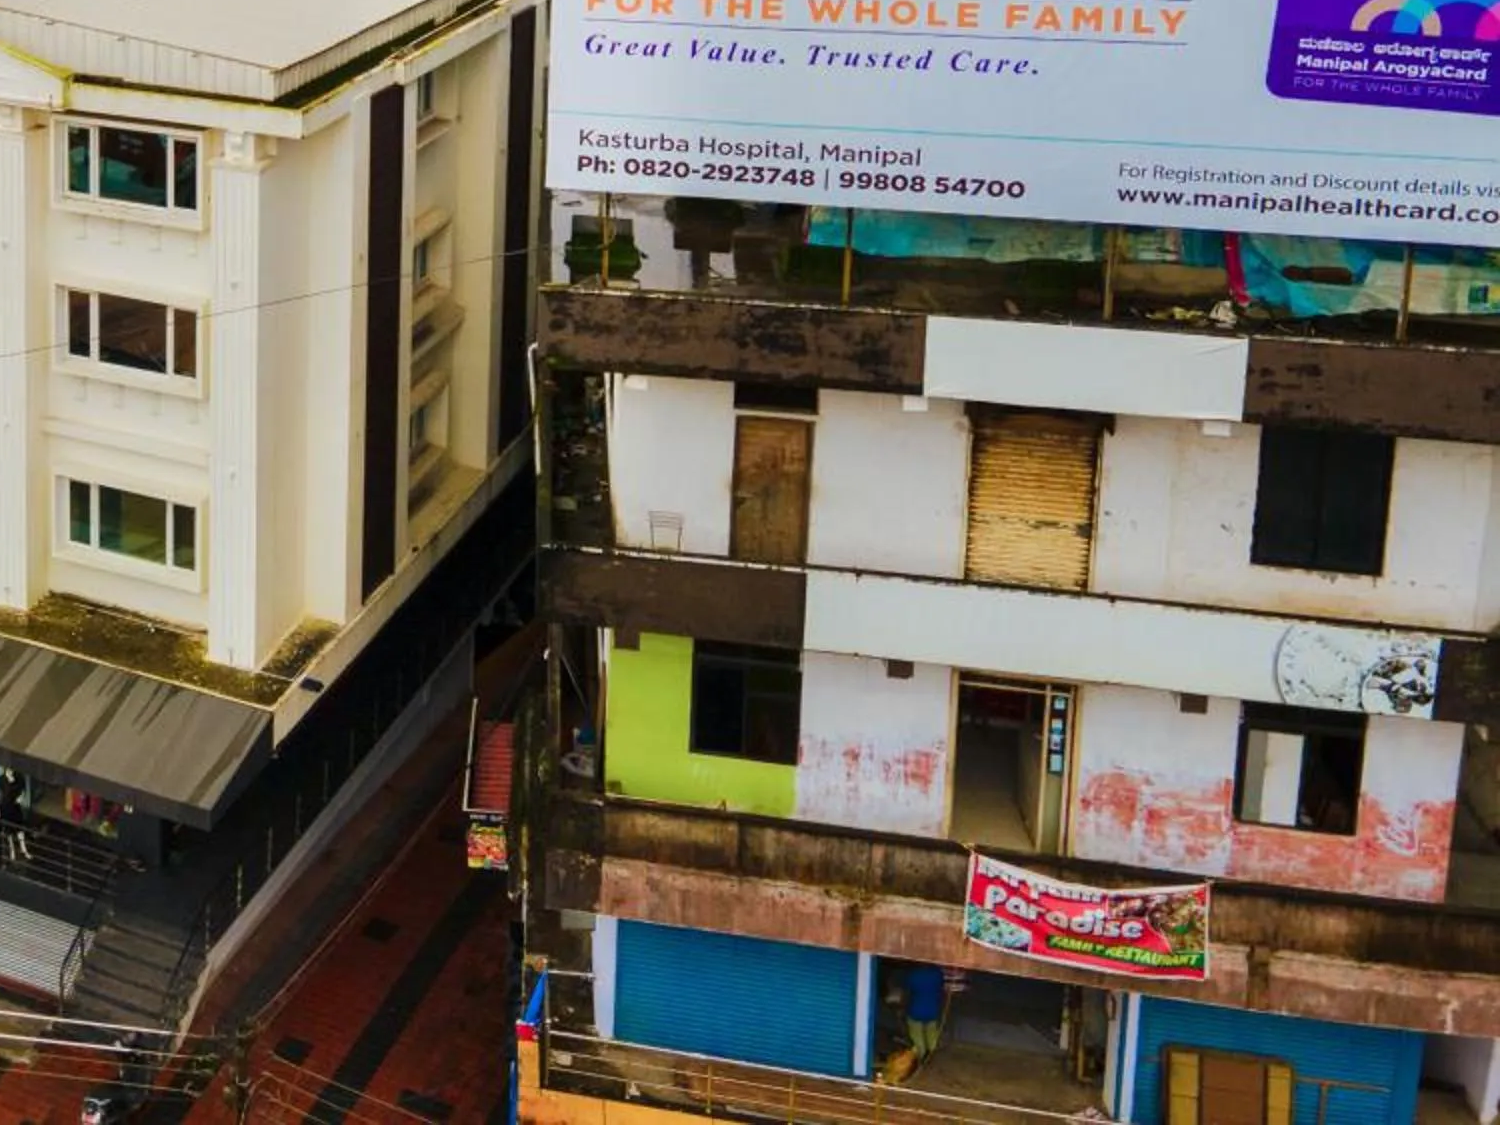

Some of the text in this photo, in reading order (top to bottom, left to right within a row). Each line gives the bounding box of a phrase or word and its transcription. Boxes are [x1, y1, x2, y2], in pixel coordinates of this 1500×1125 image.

[1005, 3, 1187, 35] FAMILY
[585, 33, 1039, 75] Great Value. Trusted Care.
[1296, 54, 1487, 82] Manipal ArogyaCard
[1293, 76, 1482, 100] FOR THE WHOLE FAMILY
[579, 128, 922, 167] Kasturba Hospital, Manipal
[577, 155, 615, 173] Ph:
[623, 157, 815, 187] 0820-2923748
[839, 171, 926, 192] 99808
[934, 177, 1026, 198] 54700
[1118, 162, 1148, 179] For
[1153, 164, 1265, 185] Registration
[1270, 172, 1307, 188] and
[1313, 174, 1399, 192] Discount
[1405, 178, 1472, 197] details
[1117, 188, 1500, 224] www.manipalhealthcard.co
[985, 884, 1144, 939] Paradise
[1050, 935, 1199, 967] FAMILY RESTAURANT
